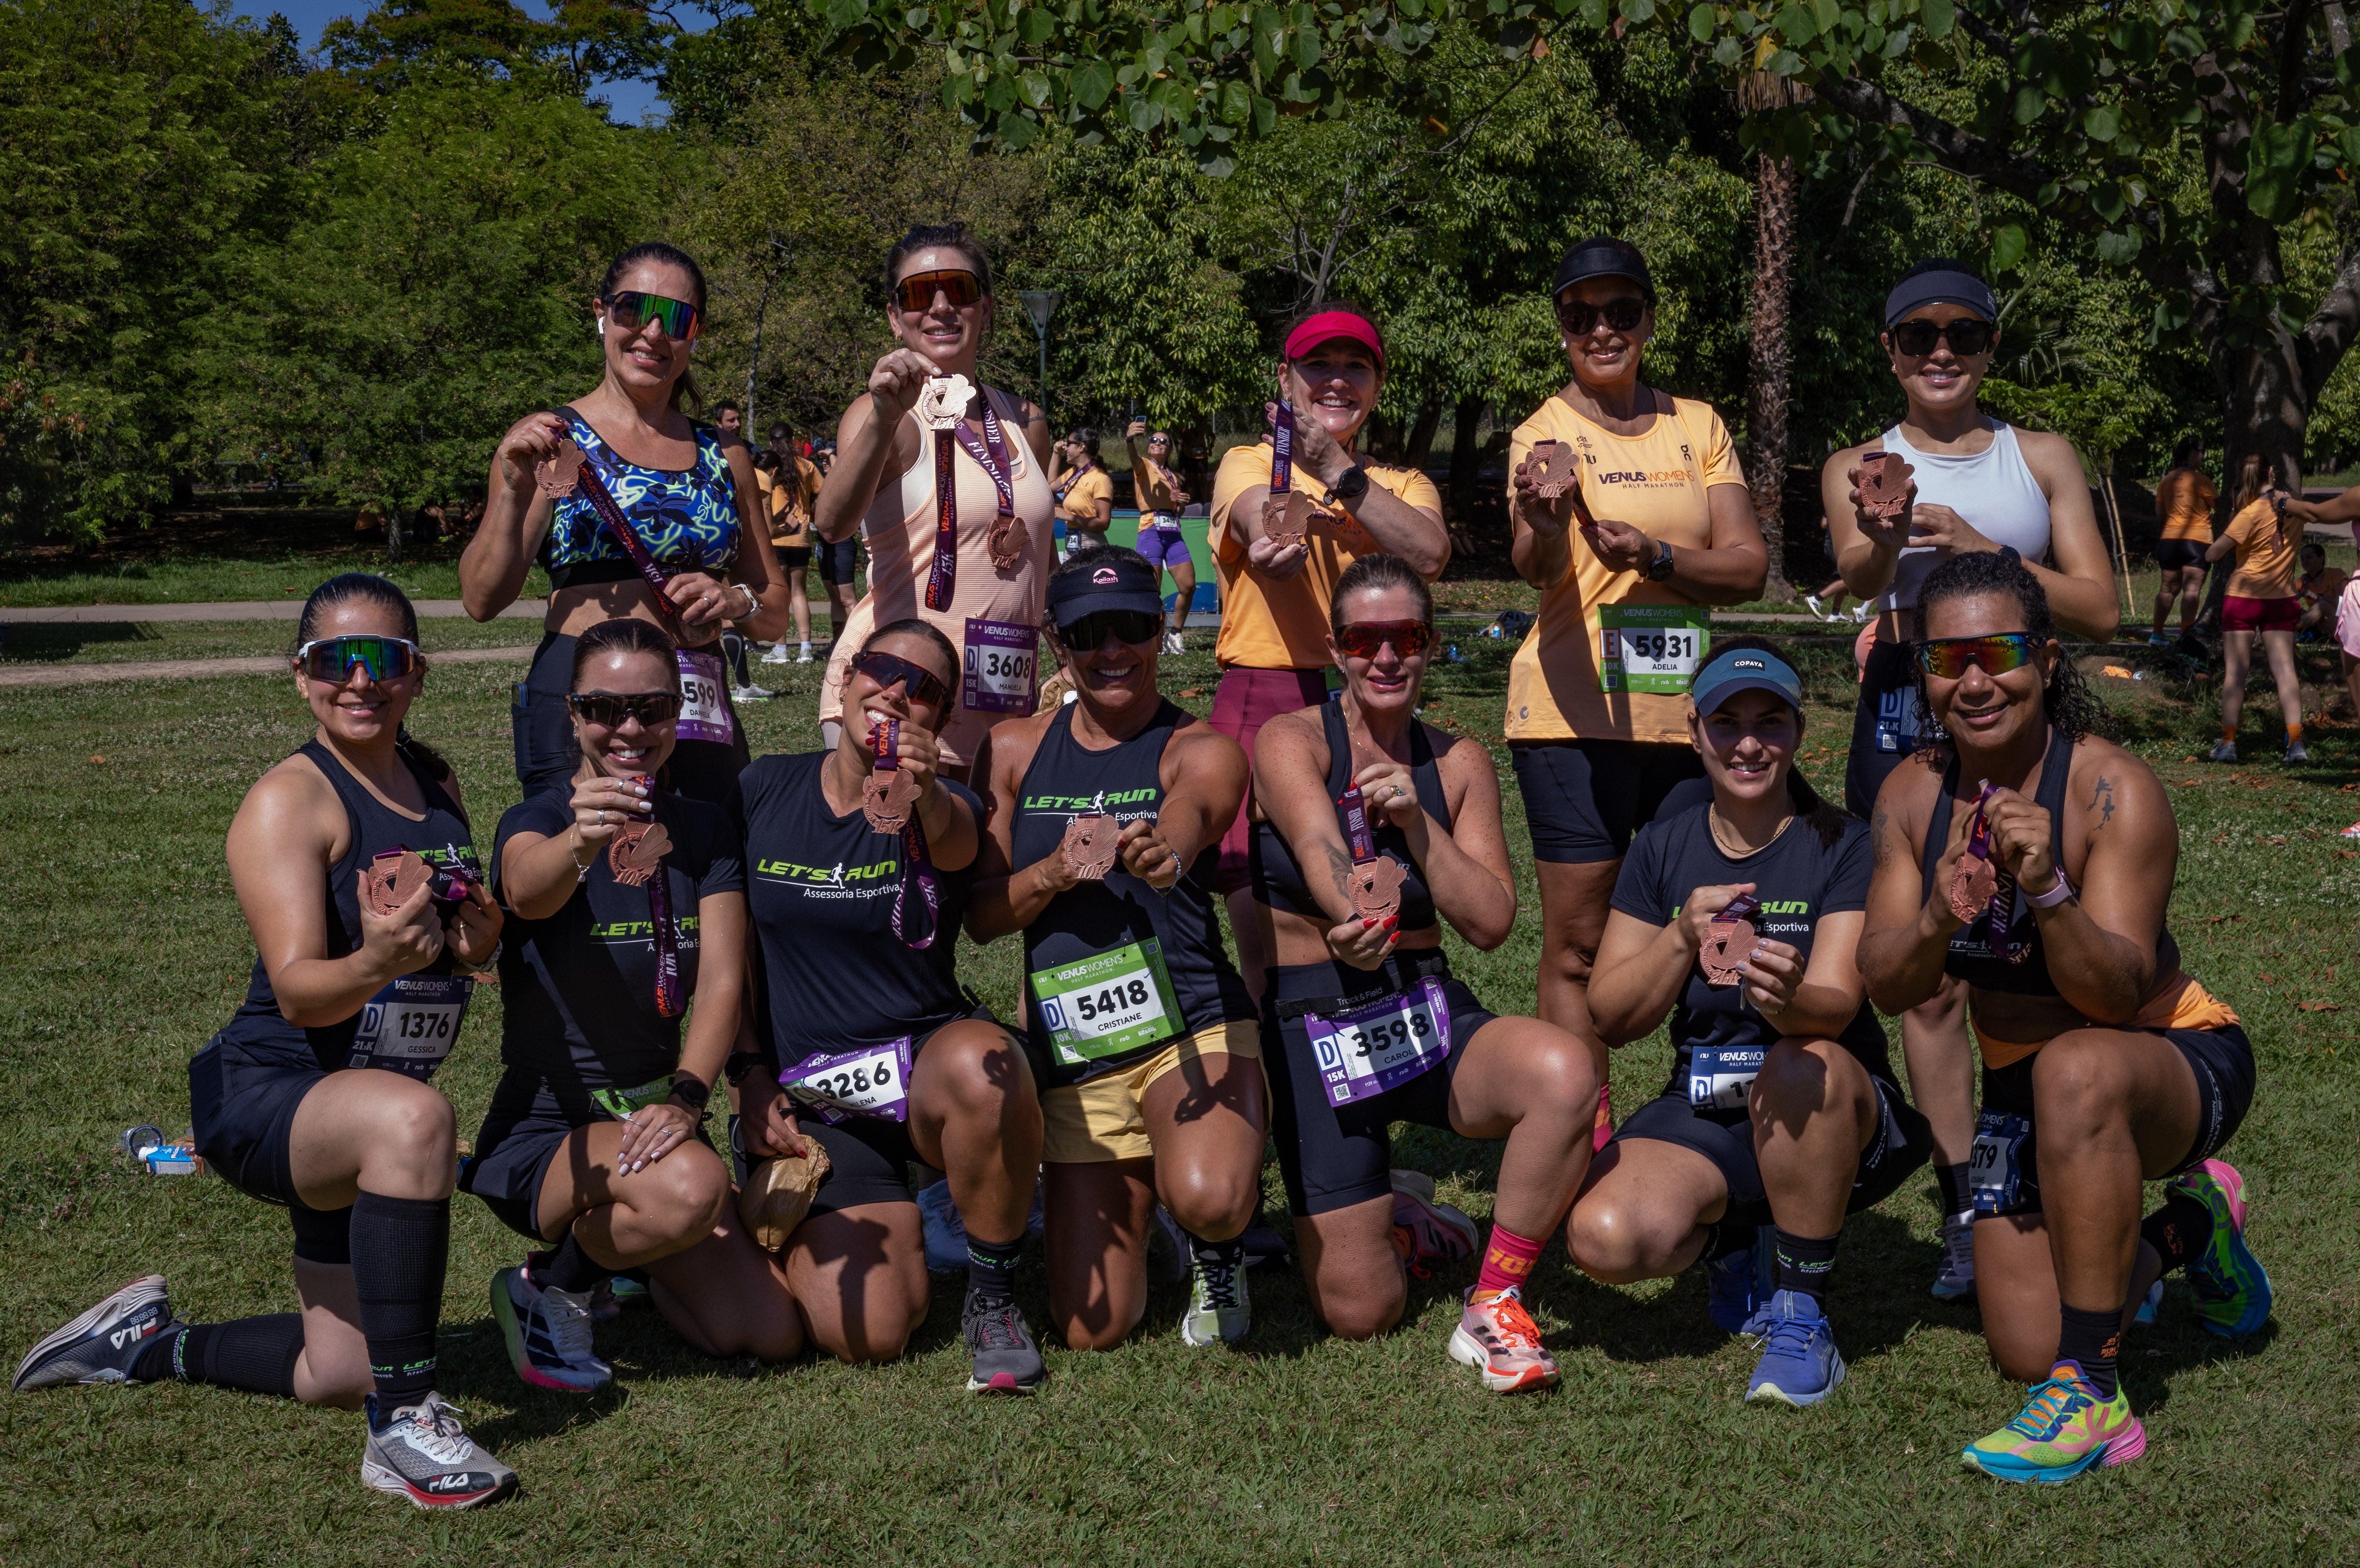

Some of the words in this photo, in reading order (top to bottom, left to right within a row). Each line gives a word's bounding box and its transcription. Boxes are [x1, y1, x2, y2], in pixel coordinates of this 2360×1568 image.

[931, 417, 960, 430] 15K
[1277, 426, 1290, 456] FINISHER
[548, 482, 573, 499] 15K
[1538, 484, 1566, 498] 10K
[941, 551, 954, 577] 15K
[928, 549, 939, 609] ENUSWOMEN'S
[1093, 575, 1118, 584] Kailash
[1605, 633, 1614, 655] E
[1636, 635, 1691, 658] 5931
[968, 648, 975, 671] D
[986, 653, 1031, 679] 3608
[966, 679, 977, 688] 15K
[684, 682, 715, 708] 599
[1885, 692, 1898, 713] D
[690, 710, 710, 719] DANIELA
[1024, 796, 1092, 809] LET'S
[1104, 788, 1156, 806] RUN
[1115, 810, 1157, 822] Esportiva
[1348, 807, 1364, 831] FINISHER
[872, 819, 904, 834] 15K
[416, 850, 447, 862] T'S
[458, 846, 477, 859] RU
[757, 859, 831, 881] LET'S
[844, 860, 896, 881] RUN
[1075, 865, 1109, 880] 10K
[804, 888, 853, 899] Assessoria
[856, 884, 899, 899] Esportiva
[1761, 901, 1808, 914] RUN
[1764, 922, 1809, 933] Esportiva
[1076, 979, 1149, 1021] 5418
[1337, 987, 1382, 1006] Track&Field
[1047, 1003, 1060, 1028] D
[1165, 1007, 1174, 1019] 5418
[1364, 1002, 1392, 1015] MARATHON
[362, 1007, 378, 1033] D
[400, 1012, 450, 1038] 1376
[1098, 1012, 1142, 1031] CRISTIANE
[1054, 1032, 1072, 1044] 10K
[1351, 1013, 1430, 1057] 3598
[830, 1051, 858, 1062] MARATHON
[1319, 1041, 1335, 1066] D
[1385, 1049, 1413, 1064] CAROL
[816, 1061, 891, 1100] 3286
[1327, 1070, 1346, 1083] 15K
[1695, 1080, 1707, 1102] D
[813, 1101, 830, 1110] 15K
[849, 1096, 876, 1108] MILENA
[1970, 1144, 1998, 1169] 379
[110, 1317, 157, 1350] FILA
[429, 1473, 468, 1492] FILA
